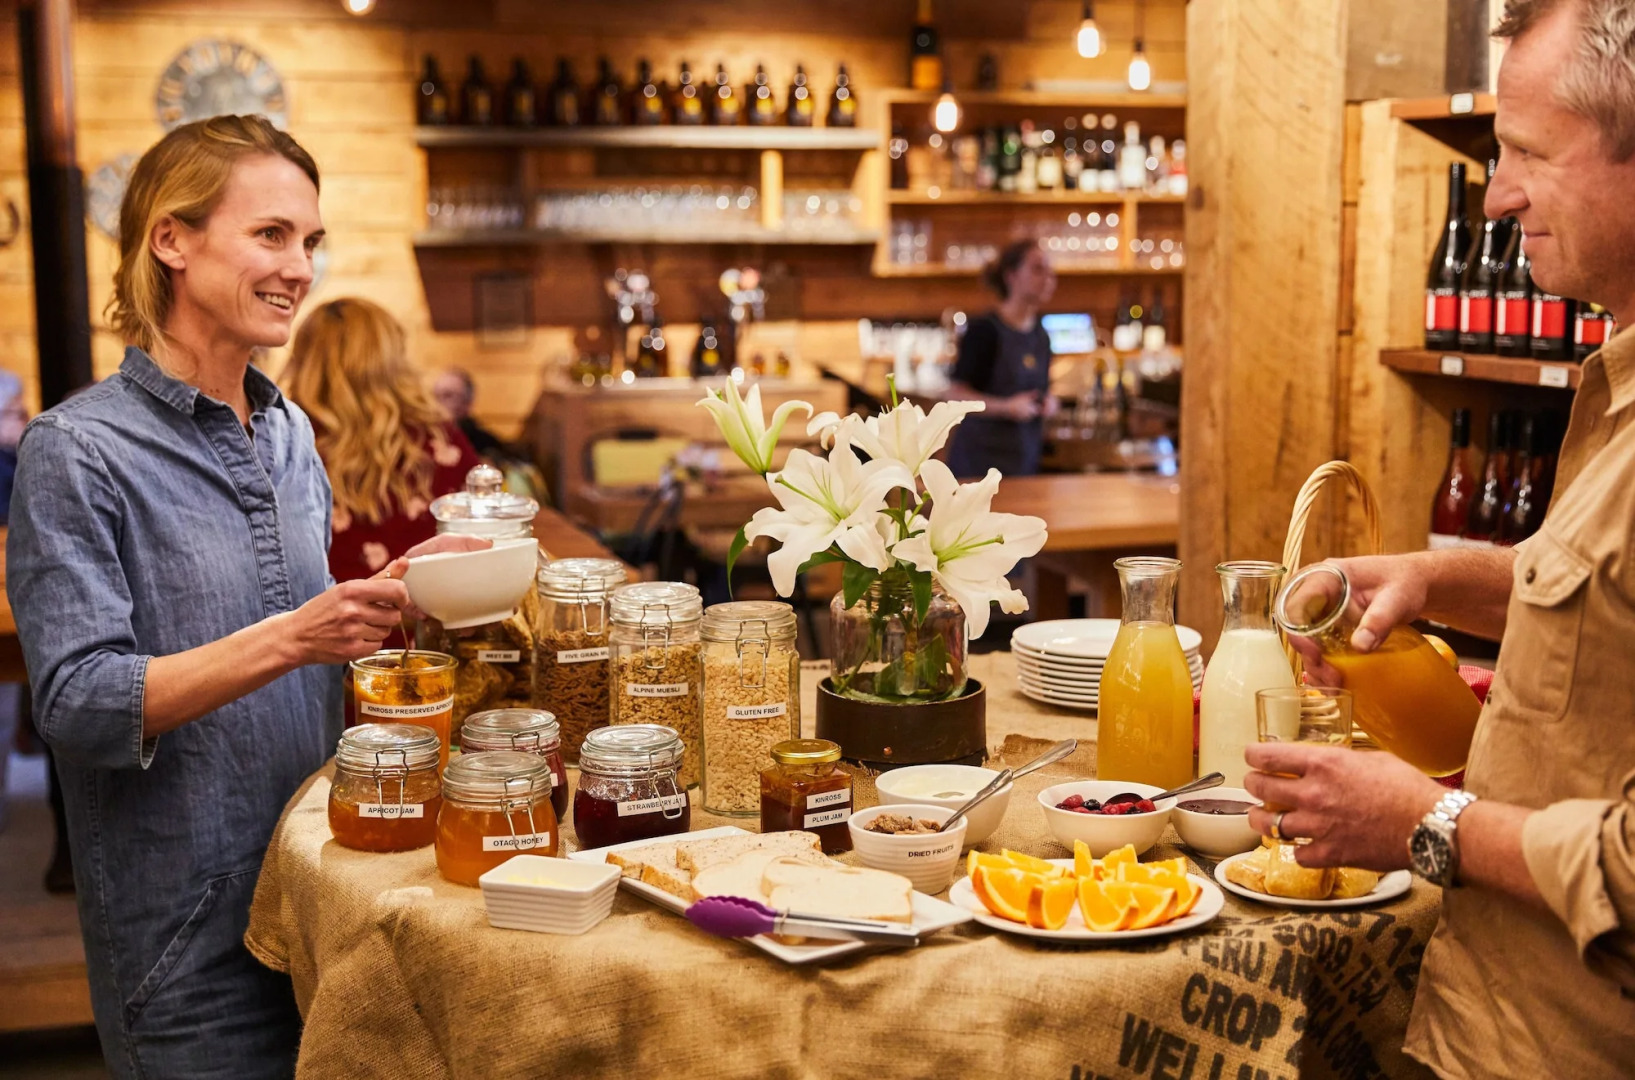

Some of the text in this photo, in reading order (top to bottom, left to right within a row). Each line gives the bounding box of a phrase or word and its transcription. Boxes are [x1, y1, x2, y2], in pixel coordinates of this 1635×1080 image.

[580, 651, 600, 659] GRAIN
[633, 686, 681, 694] ALPINE MUESLI
[367, 705, 393, 715] KINROSS
[395, 705, 435, 715] PRESERVED
[735, 706, 780, 717] GLUTEN FREE
[814, 793, 842, 804] KINROSS
[812, 812, 843, 823] PLUM JAM
[493, 839, 520, 847] OTAGO
[908, 844, 954, 858] DRIED FRUITS
[1179, 936, 1267, 983] PERU
[1181, 972, 1282, 1052] CROP
